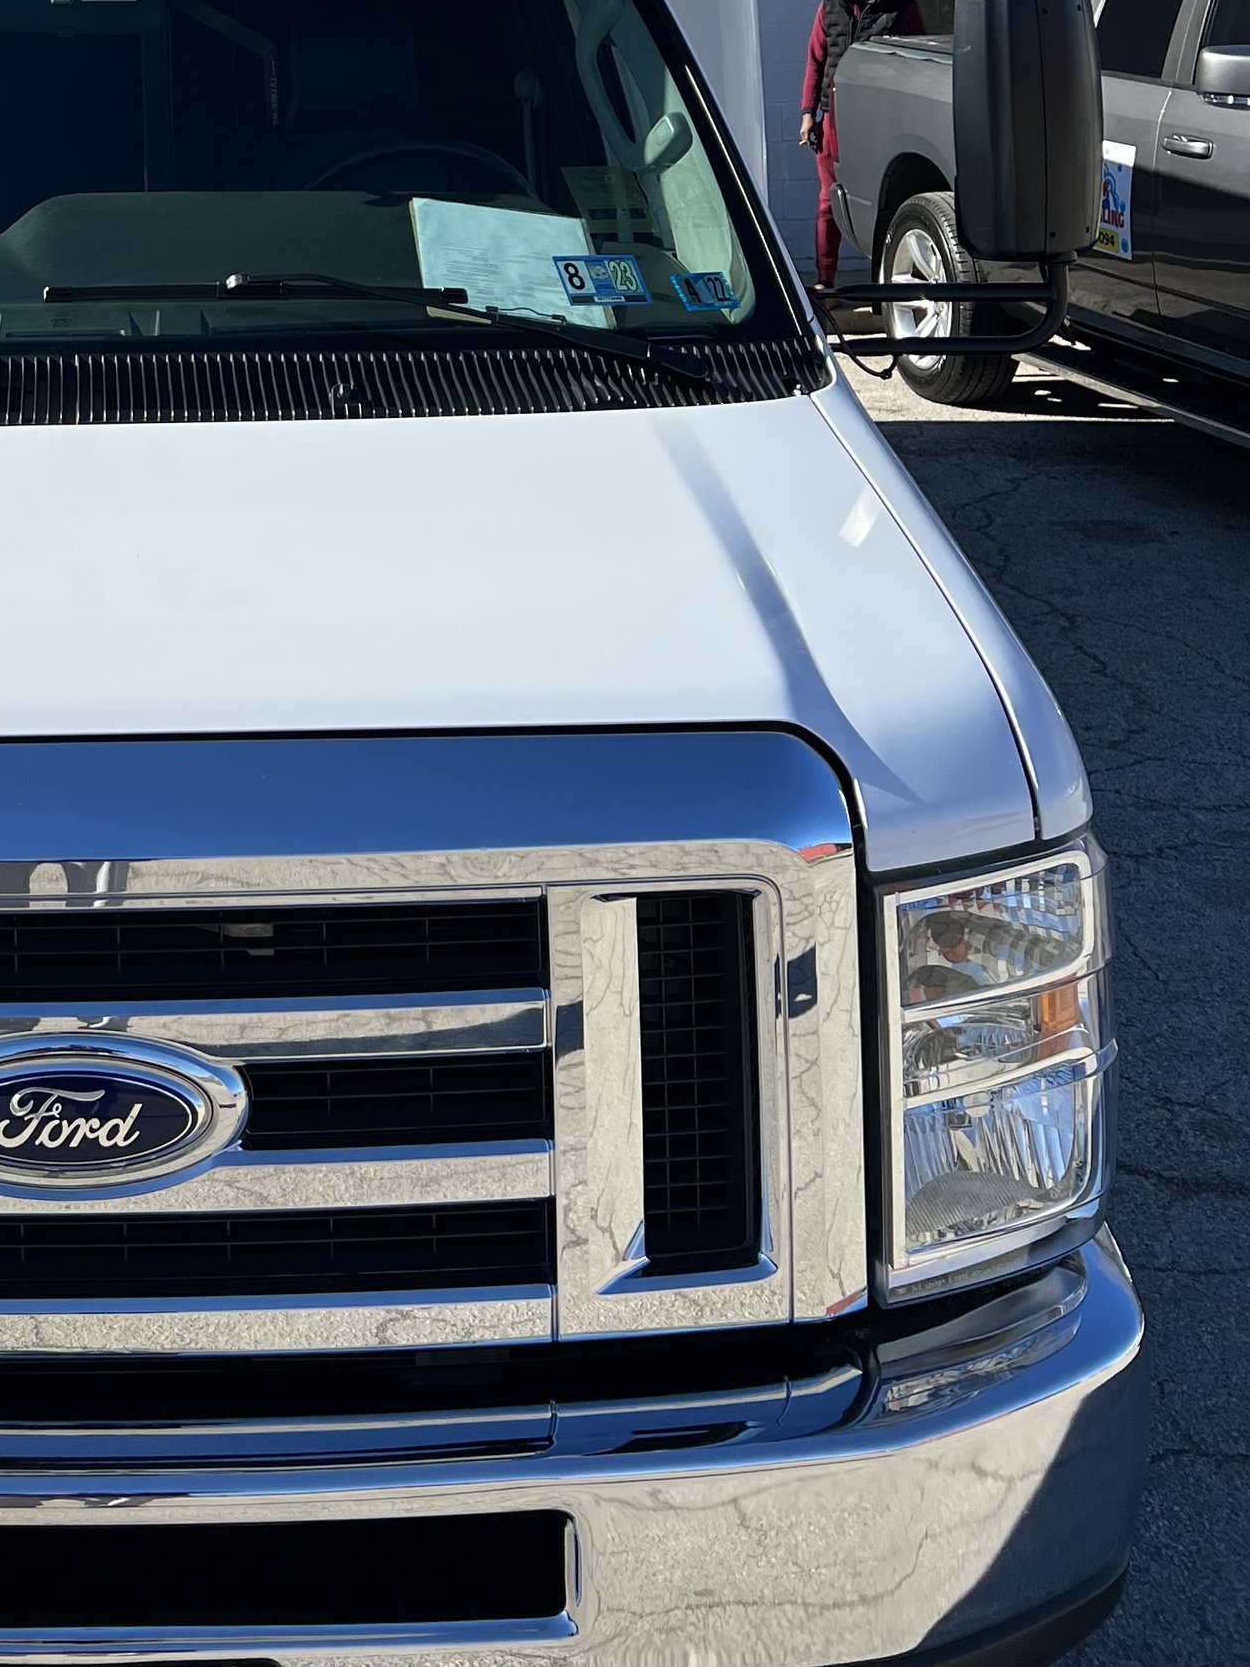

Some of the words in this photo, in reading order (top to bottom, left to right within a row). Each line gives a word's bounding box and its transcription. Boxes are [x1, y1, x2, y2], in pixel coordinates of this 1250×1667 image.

[1100, 209, 1125, 229] LING
[564, 262, 586, 291] 8
[608, 259, 639, 293] 23
[706, 276, 733, 302] 22
